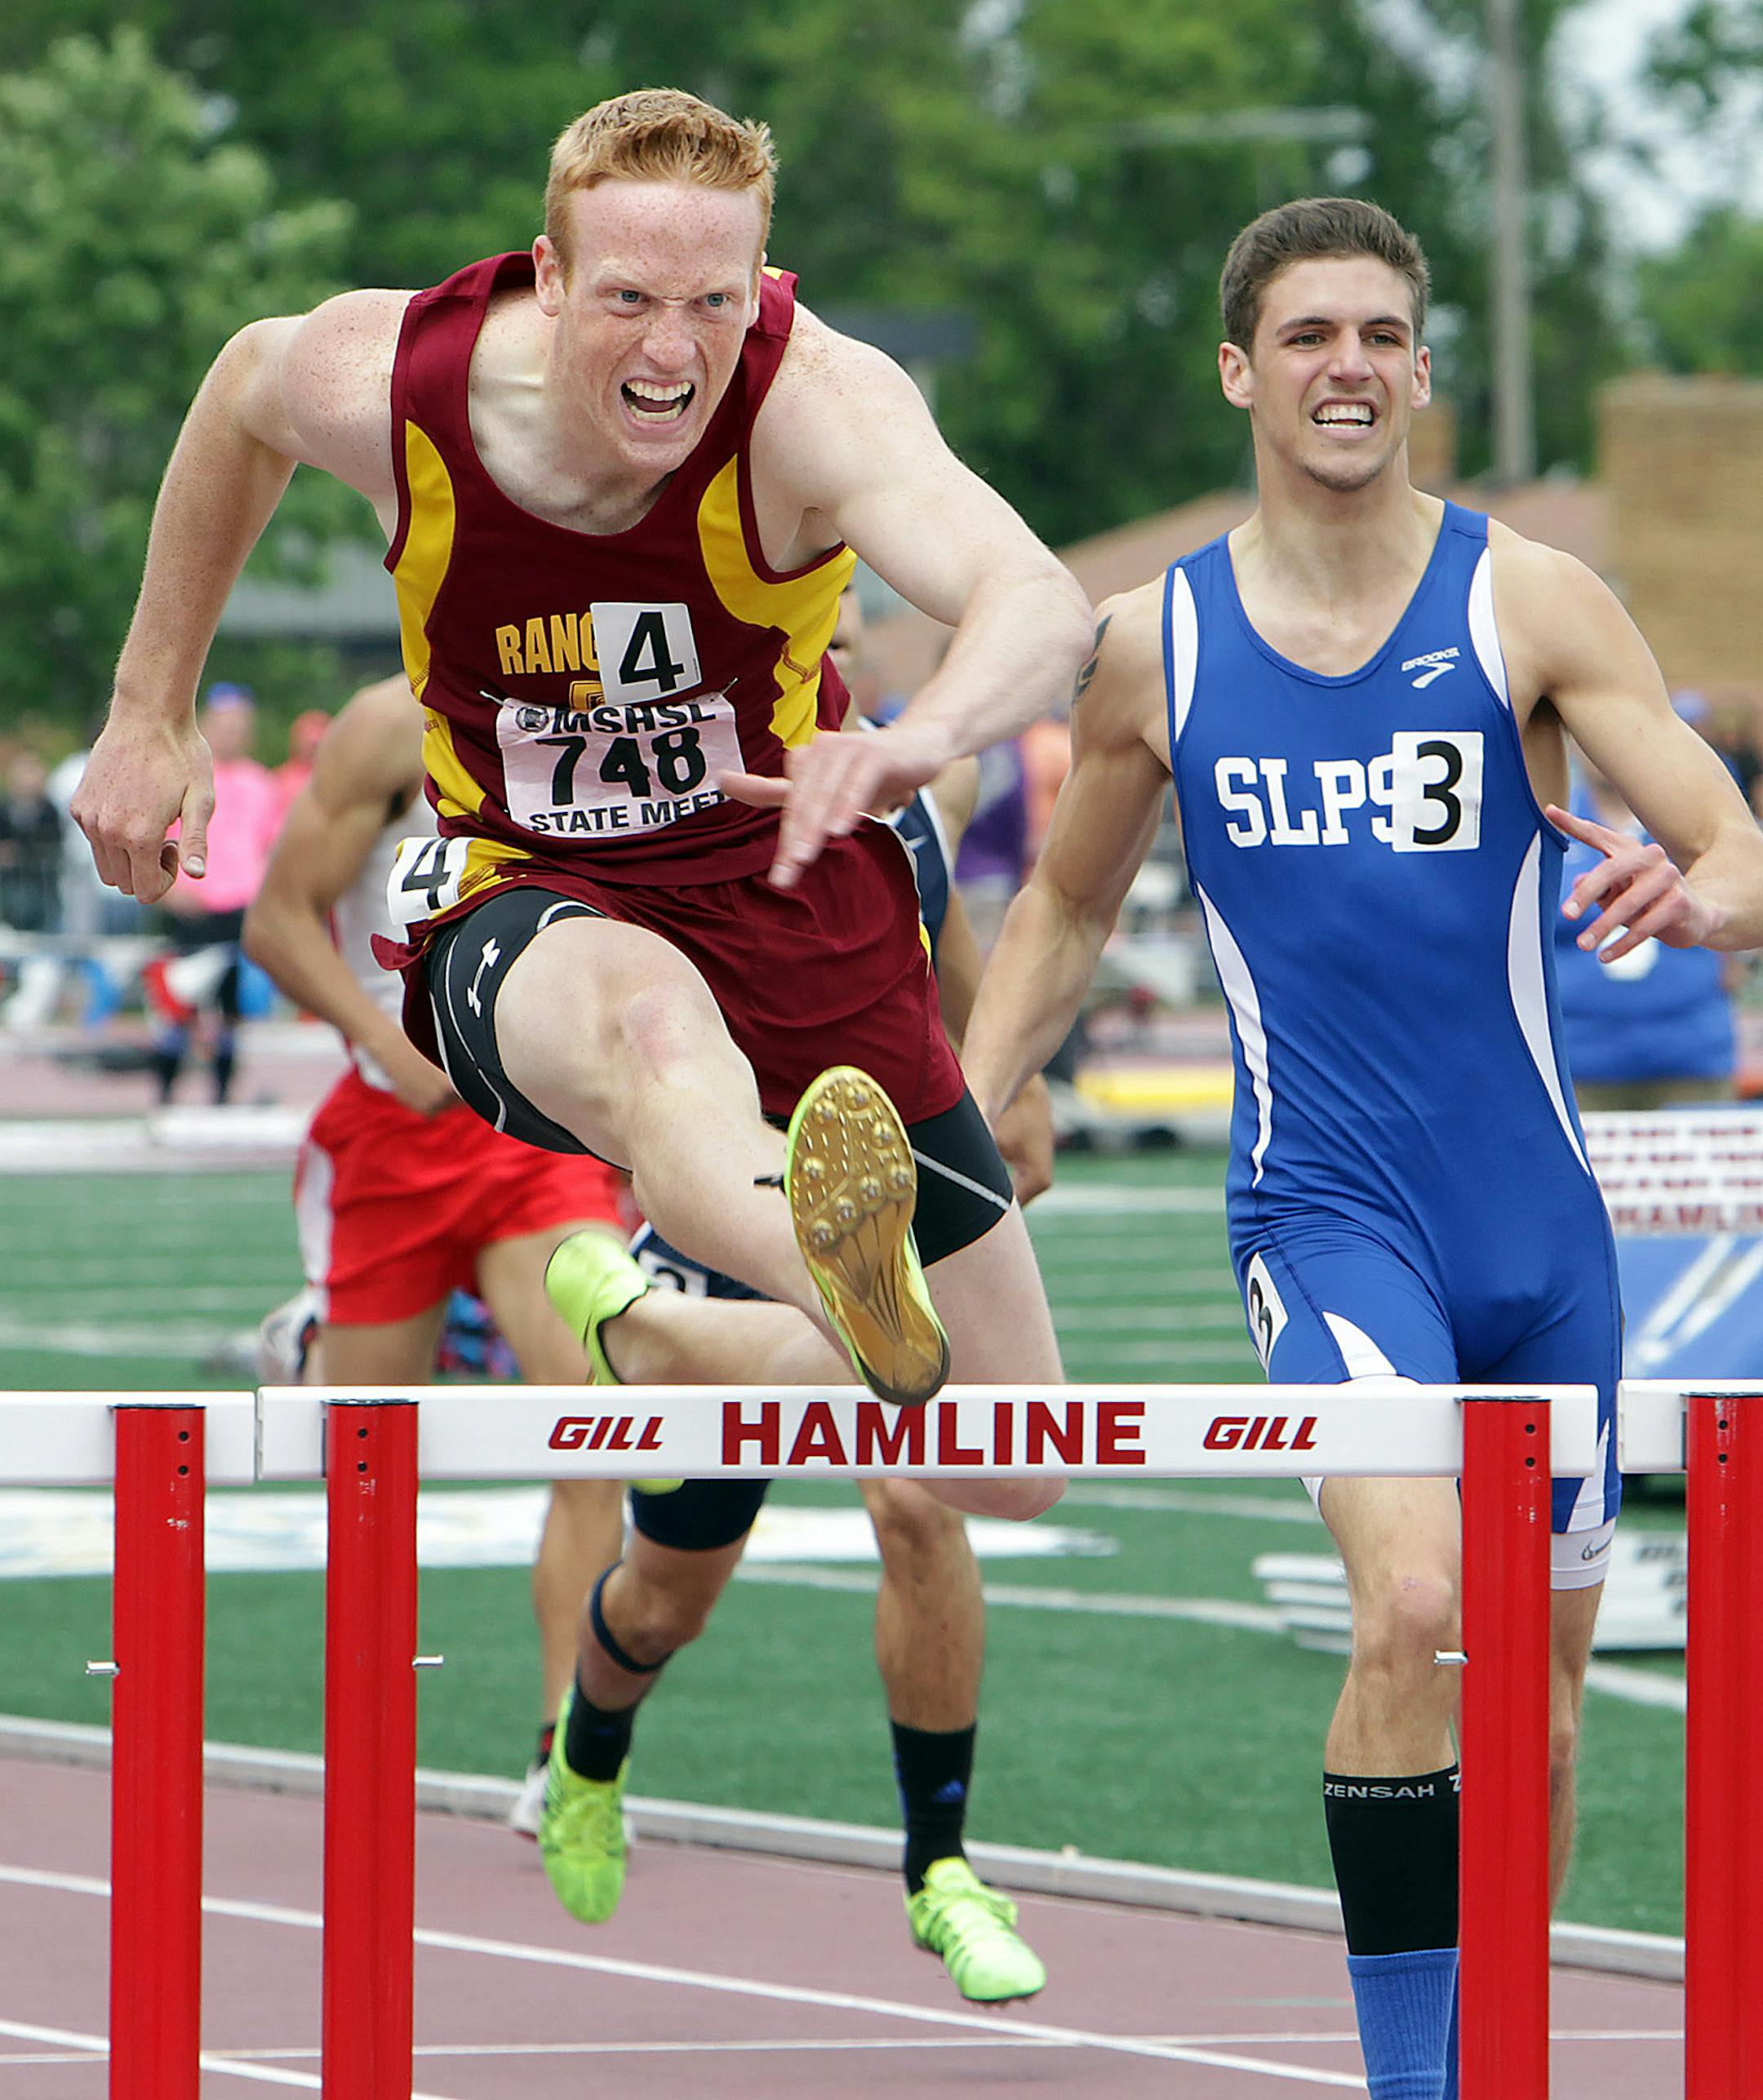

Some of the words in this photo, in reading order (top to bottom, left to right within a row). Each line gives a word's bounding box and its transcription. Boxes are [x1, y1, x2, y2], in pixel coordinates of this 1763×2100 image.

[618, 611, 685, 693] 4
[551, 703, 717, 735] MSHSL
[535, 726, 707, 806] 748
[1412, 739, 1463, 846] 3
[529, 805, 630, 832] STATE
[640, 788, 726, 825] MEET
[401, 837, 452, 911] 4
[547, 1416, 665, 1451] GILL
[721, 1401, 1147, 1466] HAMLINE
[1202, 1416, 1319, 1451] GILL
[1323, 1782, 1435, 1799] ZENSAH
